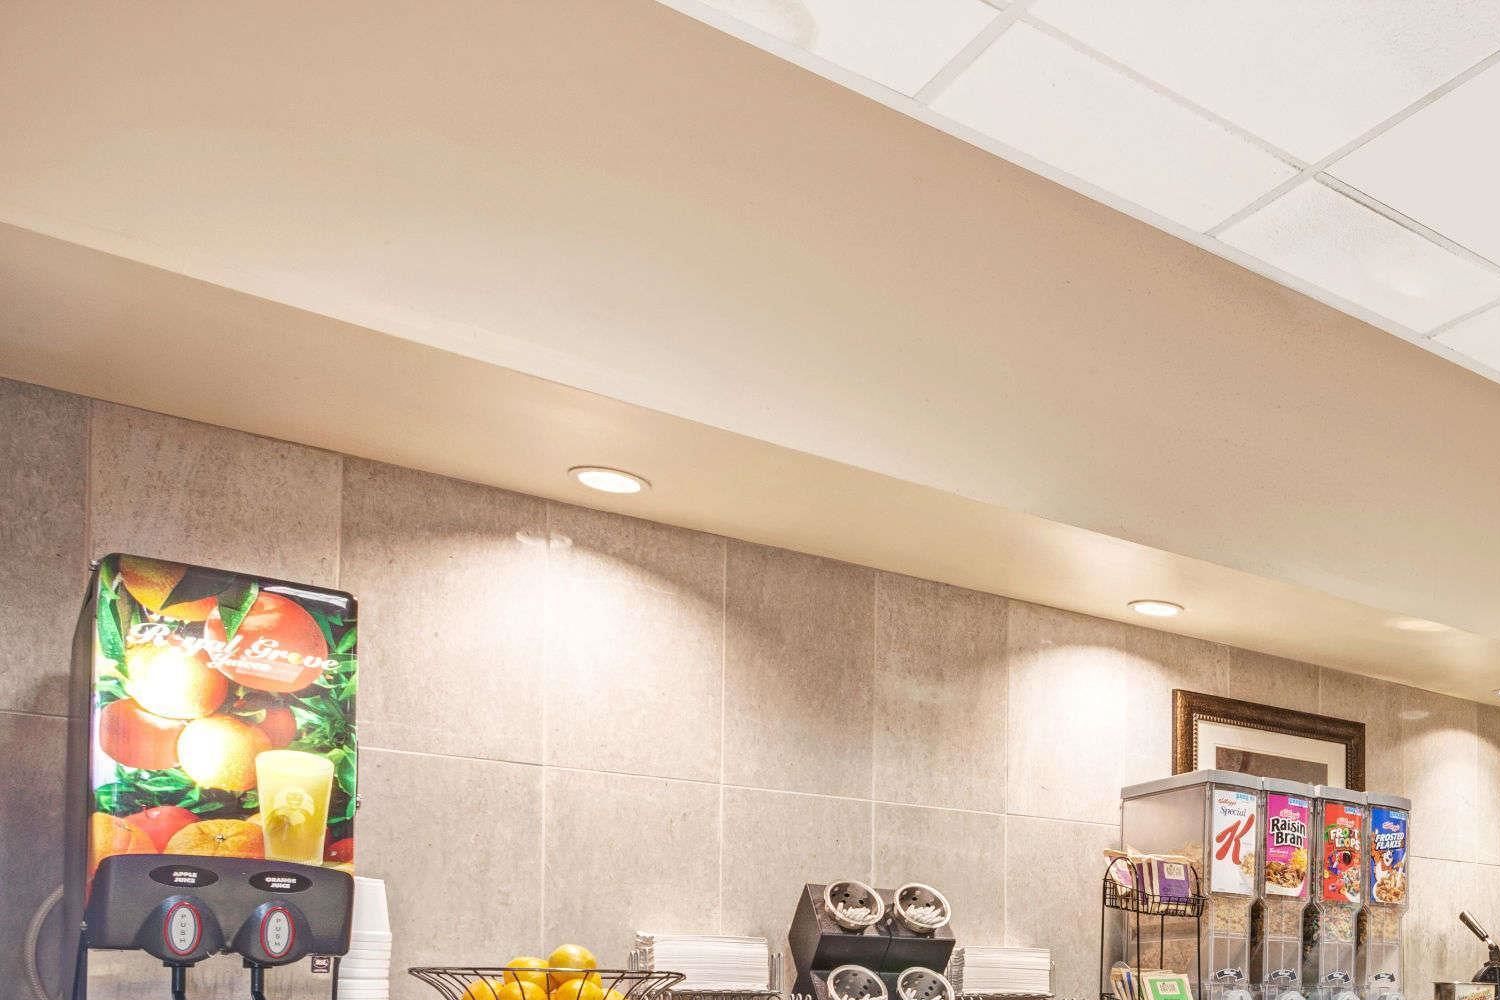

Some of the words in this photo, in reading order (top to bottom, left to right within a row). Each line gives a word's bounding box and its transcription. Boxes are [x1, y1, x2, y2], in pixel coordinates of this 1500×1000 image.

[126, 623, 243, 662] Royal
[244, 636, 341, 671] Grove
[1220, 806, 1247, 817] Special
[1271, 817, 1306, 836] Raisin
[1215, 813, 1255, 865] K
[1275, 832, 1303, 848] Bran
[1335, 837, 1360, 850] LOOPS
[1375, 832, 1405, 843] FROSTED
[1376, 840, 1402, 850] FLAKES
[179, 913, 187, 944] PUSH
